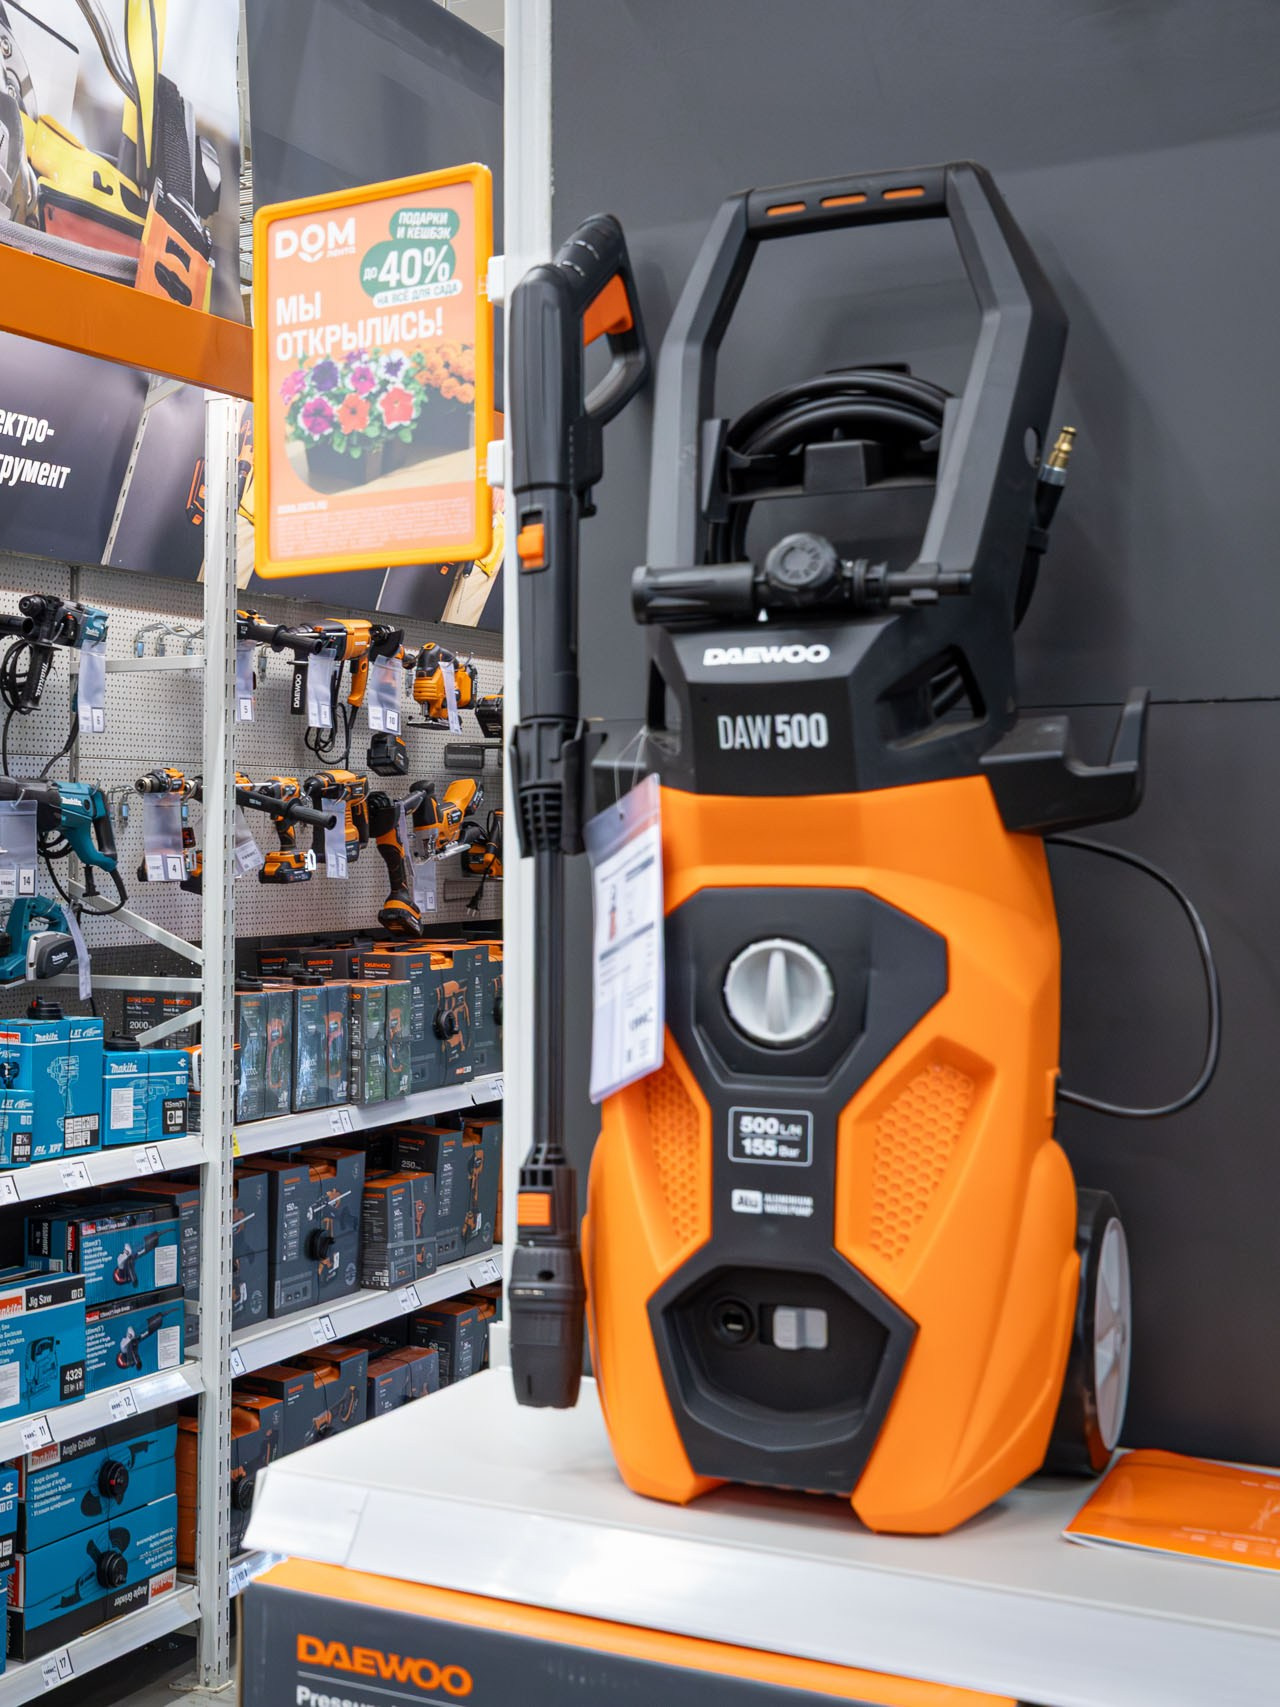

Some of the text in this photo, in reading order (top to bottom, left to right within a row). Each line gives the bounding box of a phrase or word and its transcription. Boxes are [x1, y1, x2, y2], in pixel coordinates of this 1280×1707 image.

[398, 211, 448, 225] ПОДАРКИ
[275, 217, 356, 260] DOM
[396, 226, 451, 239] И КЕШБЭК
[378, 245, 450, 288] 40%
[433, 282, 459, 297] САДА
[276, 291, 322, 326] МЫ
[276, 306, 444, 361] ОТКРЫЛИСЬ!
[703, 644, 831, 666] DAEWOO
[293, 673, 303, 708] DAEWOO
[718, 712, 829, 750] DAW 500
[23, 876, 31, 887] 14
[129, 1021, 149, 1030] 2000
[739, 1115, 803, 1137] 500 L/H
[741, 1137, 801, 1159] 155 Bar
[151, 1155, 157, 1164] 5
[401, 1160, 416, 1169] 250
[79, 1170, 84, 1180] 4
[6, 1184, 12, 1195] 3
[28, 1295, 52, 1308] Jig Saw
[65, 1368, 83, 1381] 4329
[123, 1396, 131, 1408] 12
[39, 1425, 46, 1437] 11
[62, 1436, 97, 1456] Angle Grinder
[59, 1657, 66, 1669] 17
[296, 1633, 473, 1697] DAEWOO
